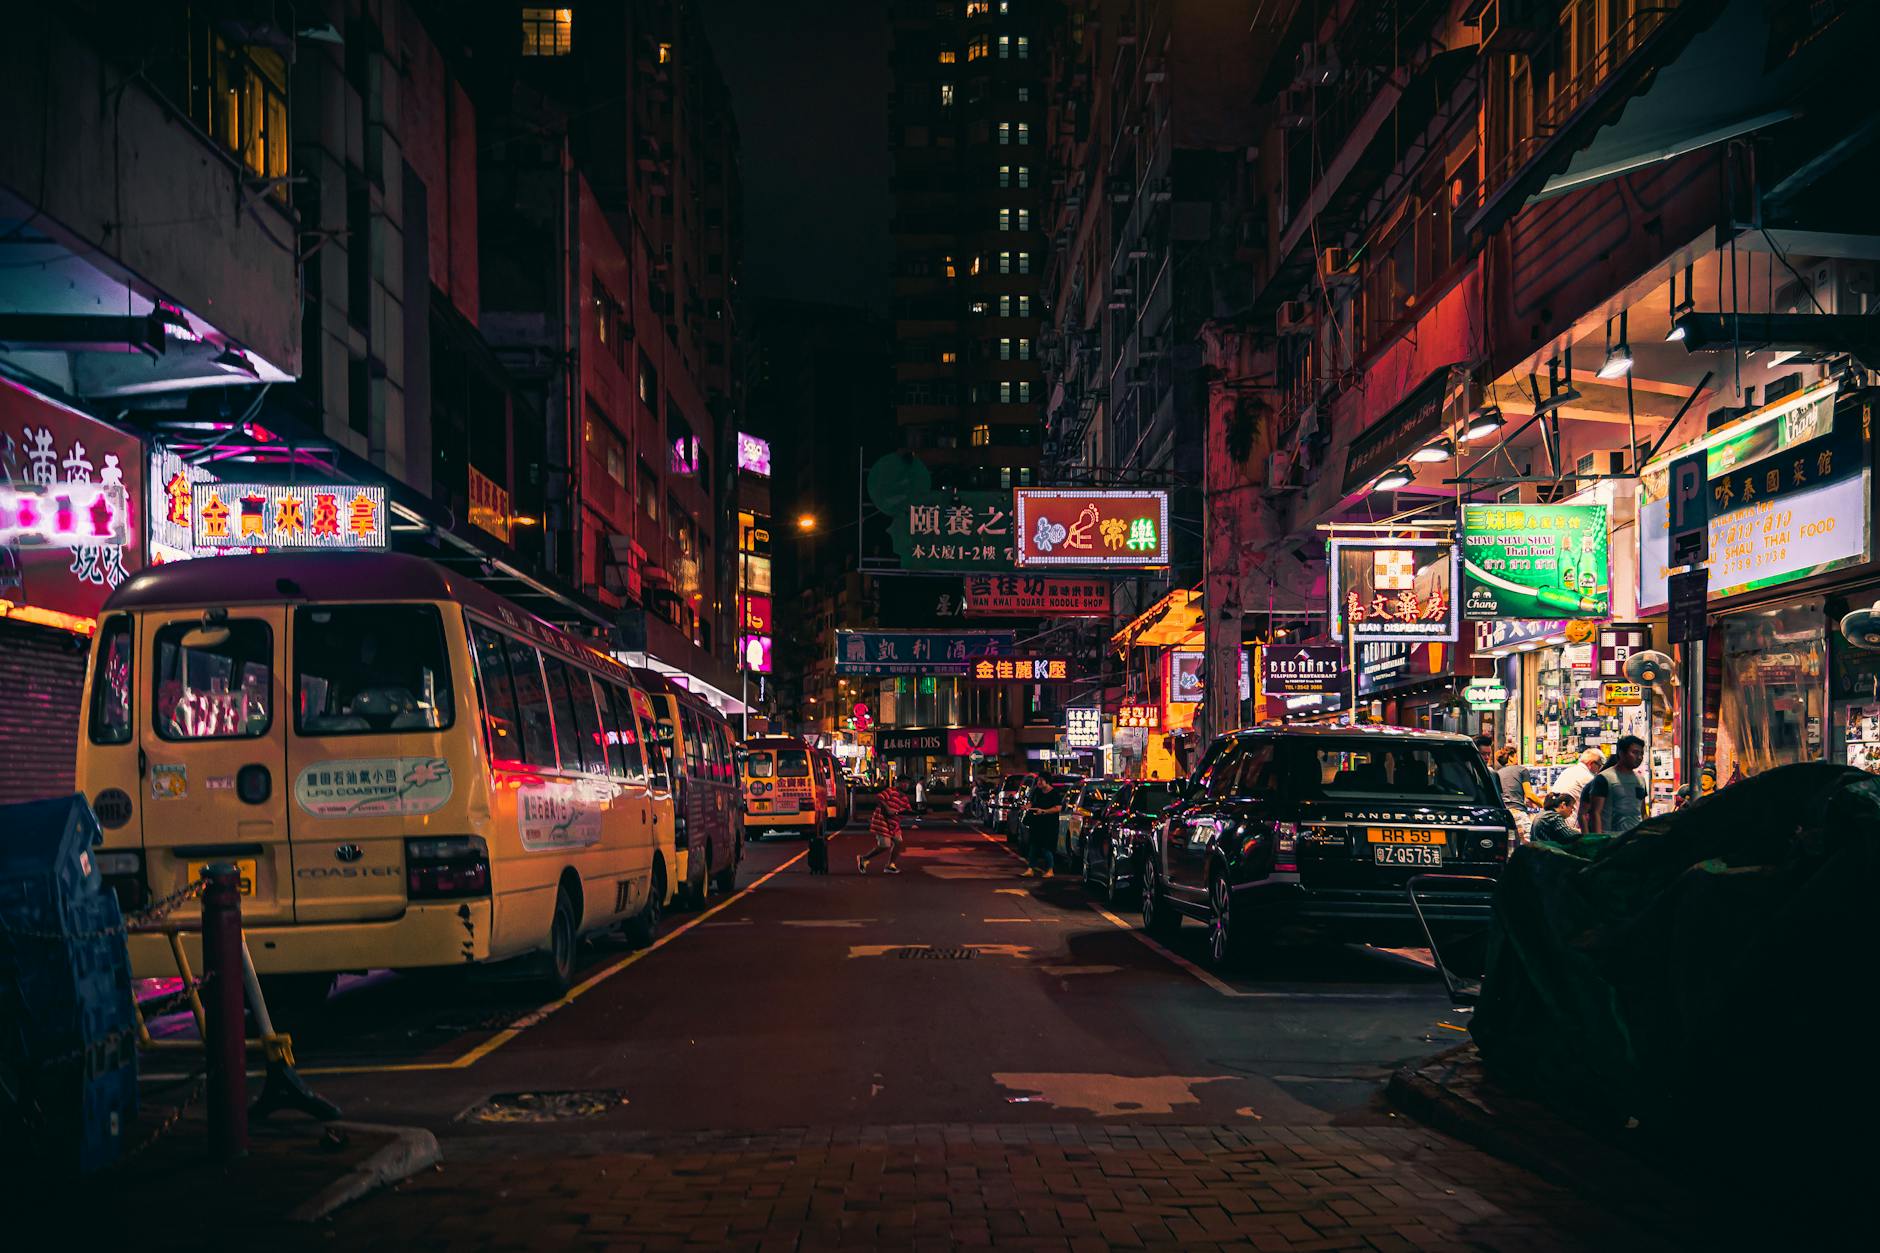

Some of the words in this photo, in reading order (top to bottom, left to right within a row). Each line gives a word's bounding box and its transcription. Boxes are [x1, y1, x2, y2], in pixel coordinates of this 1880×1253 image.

[910, 505, 1013, 536] 頤養之
[1467, 535, 1494, 545] SHAU
[1497, 535, 1524, 545] SHAU
[1527, 535, 1555, 545] SHAU
[1724, 541, 1753, 561] SHAU
[1764, 531, 1791, 548] THAI
[1800, 517, 1836, 539] FOOD
[1505, 546, 1528, 556] Thai
[1530, 546, 1555, 556] Food
[1016, 599, 1045, 607] SQUARE
[1049, 599, 1079, 607] NOODLE
[1466, 598, 1498, 610] Chang
[1358, 623, 1381, 632] MAN
[1384, 623, 1446, 633] DISPENSARY
[920, 735, 941, 749] DBS
[337, 786, 397, 797] COASTER
[1344, 811, 1407, 820] RANGE
[1414, 813, 1472, 821] ROVER
[1382, 829, 1405, 841] RR
[1410, 830, 1431, 842] 59
[297, 866, 401, 878] COASTER
